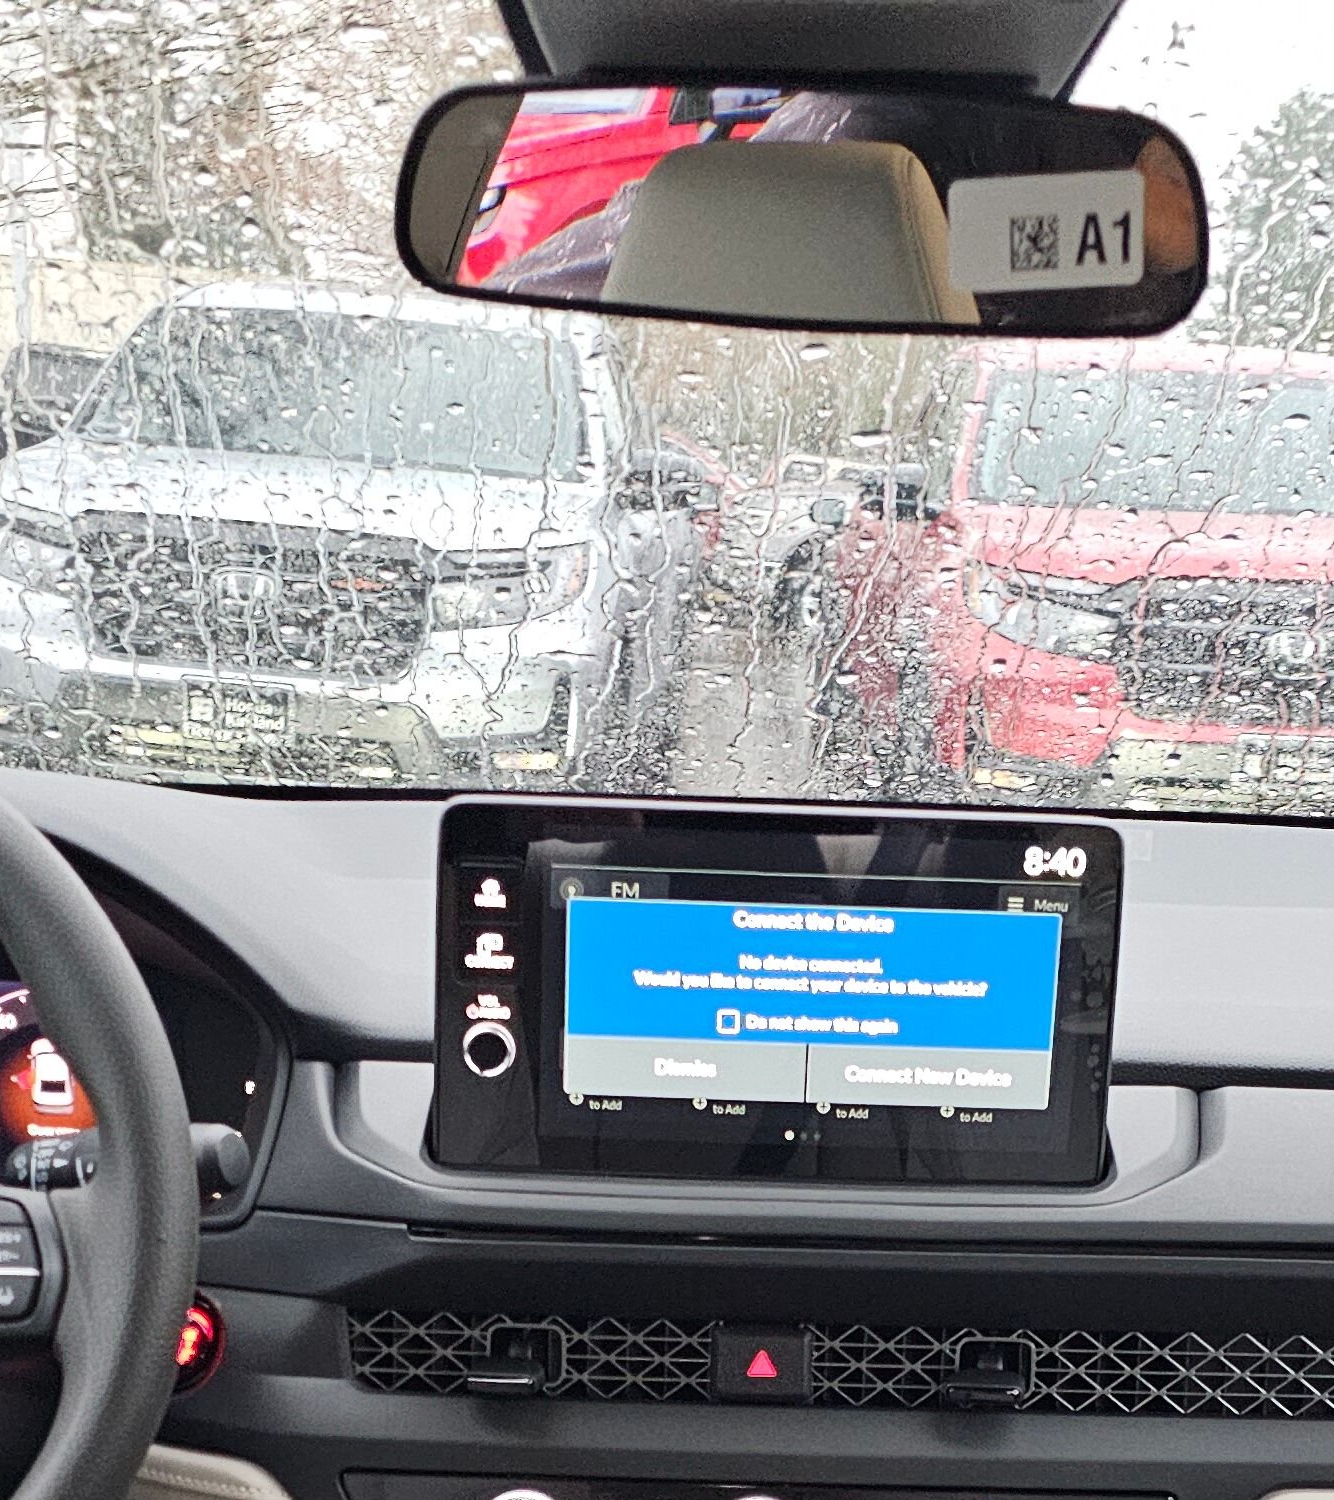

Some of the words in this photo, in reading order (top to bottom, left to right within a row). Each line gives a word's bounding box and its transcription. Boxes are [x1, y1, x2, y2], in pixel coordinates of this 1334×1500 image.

[1075, 211, 1132, 266] A1
[1023, 846, 1087, 877] 8:40
[611, 881, 640, 899] FM
[1034, 899, 1068, 912] Menu
[836, 913, 894, 933] Device
[589, 1100, 600, 1110] to
[602, 1100, 622, 1112] Add
[713, 1104, 723, 1114] to
[725, 1103, 746, 1116] Add
[837, 1108, 847, 1118] to
[848, 1107, 869, 1120] Add
[960, 1112, 971, 1122] to
[972, 1112, 993, 1124] Add
